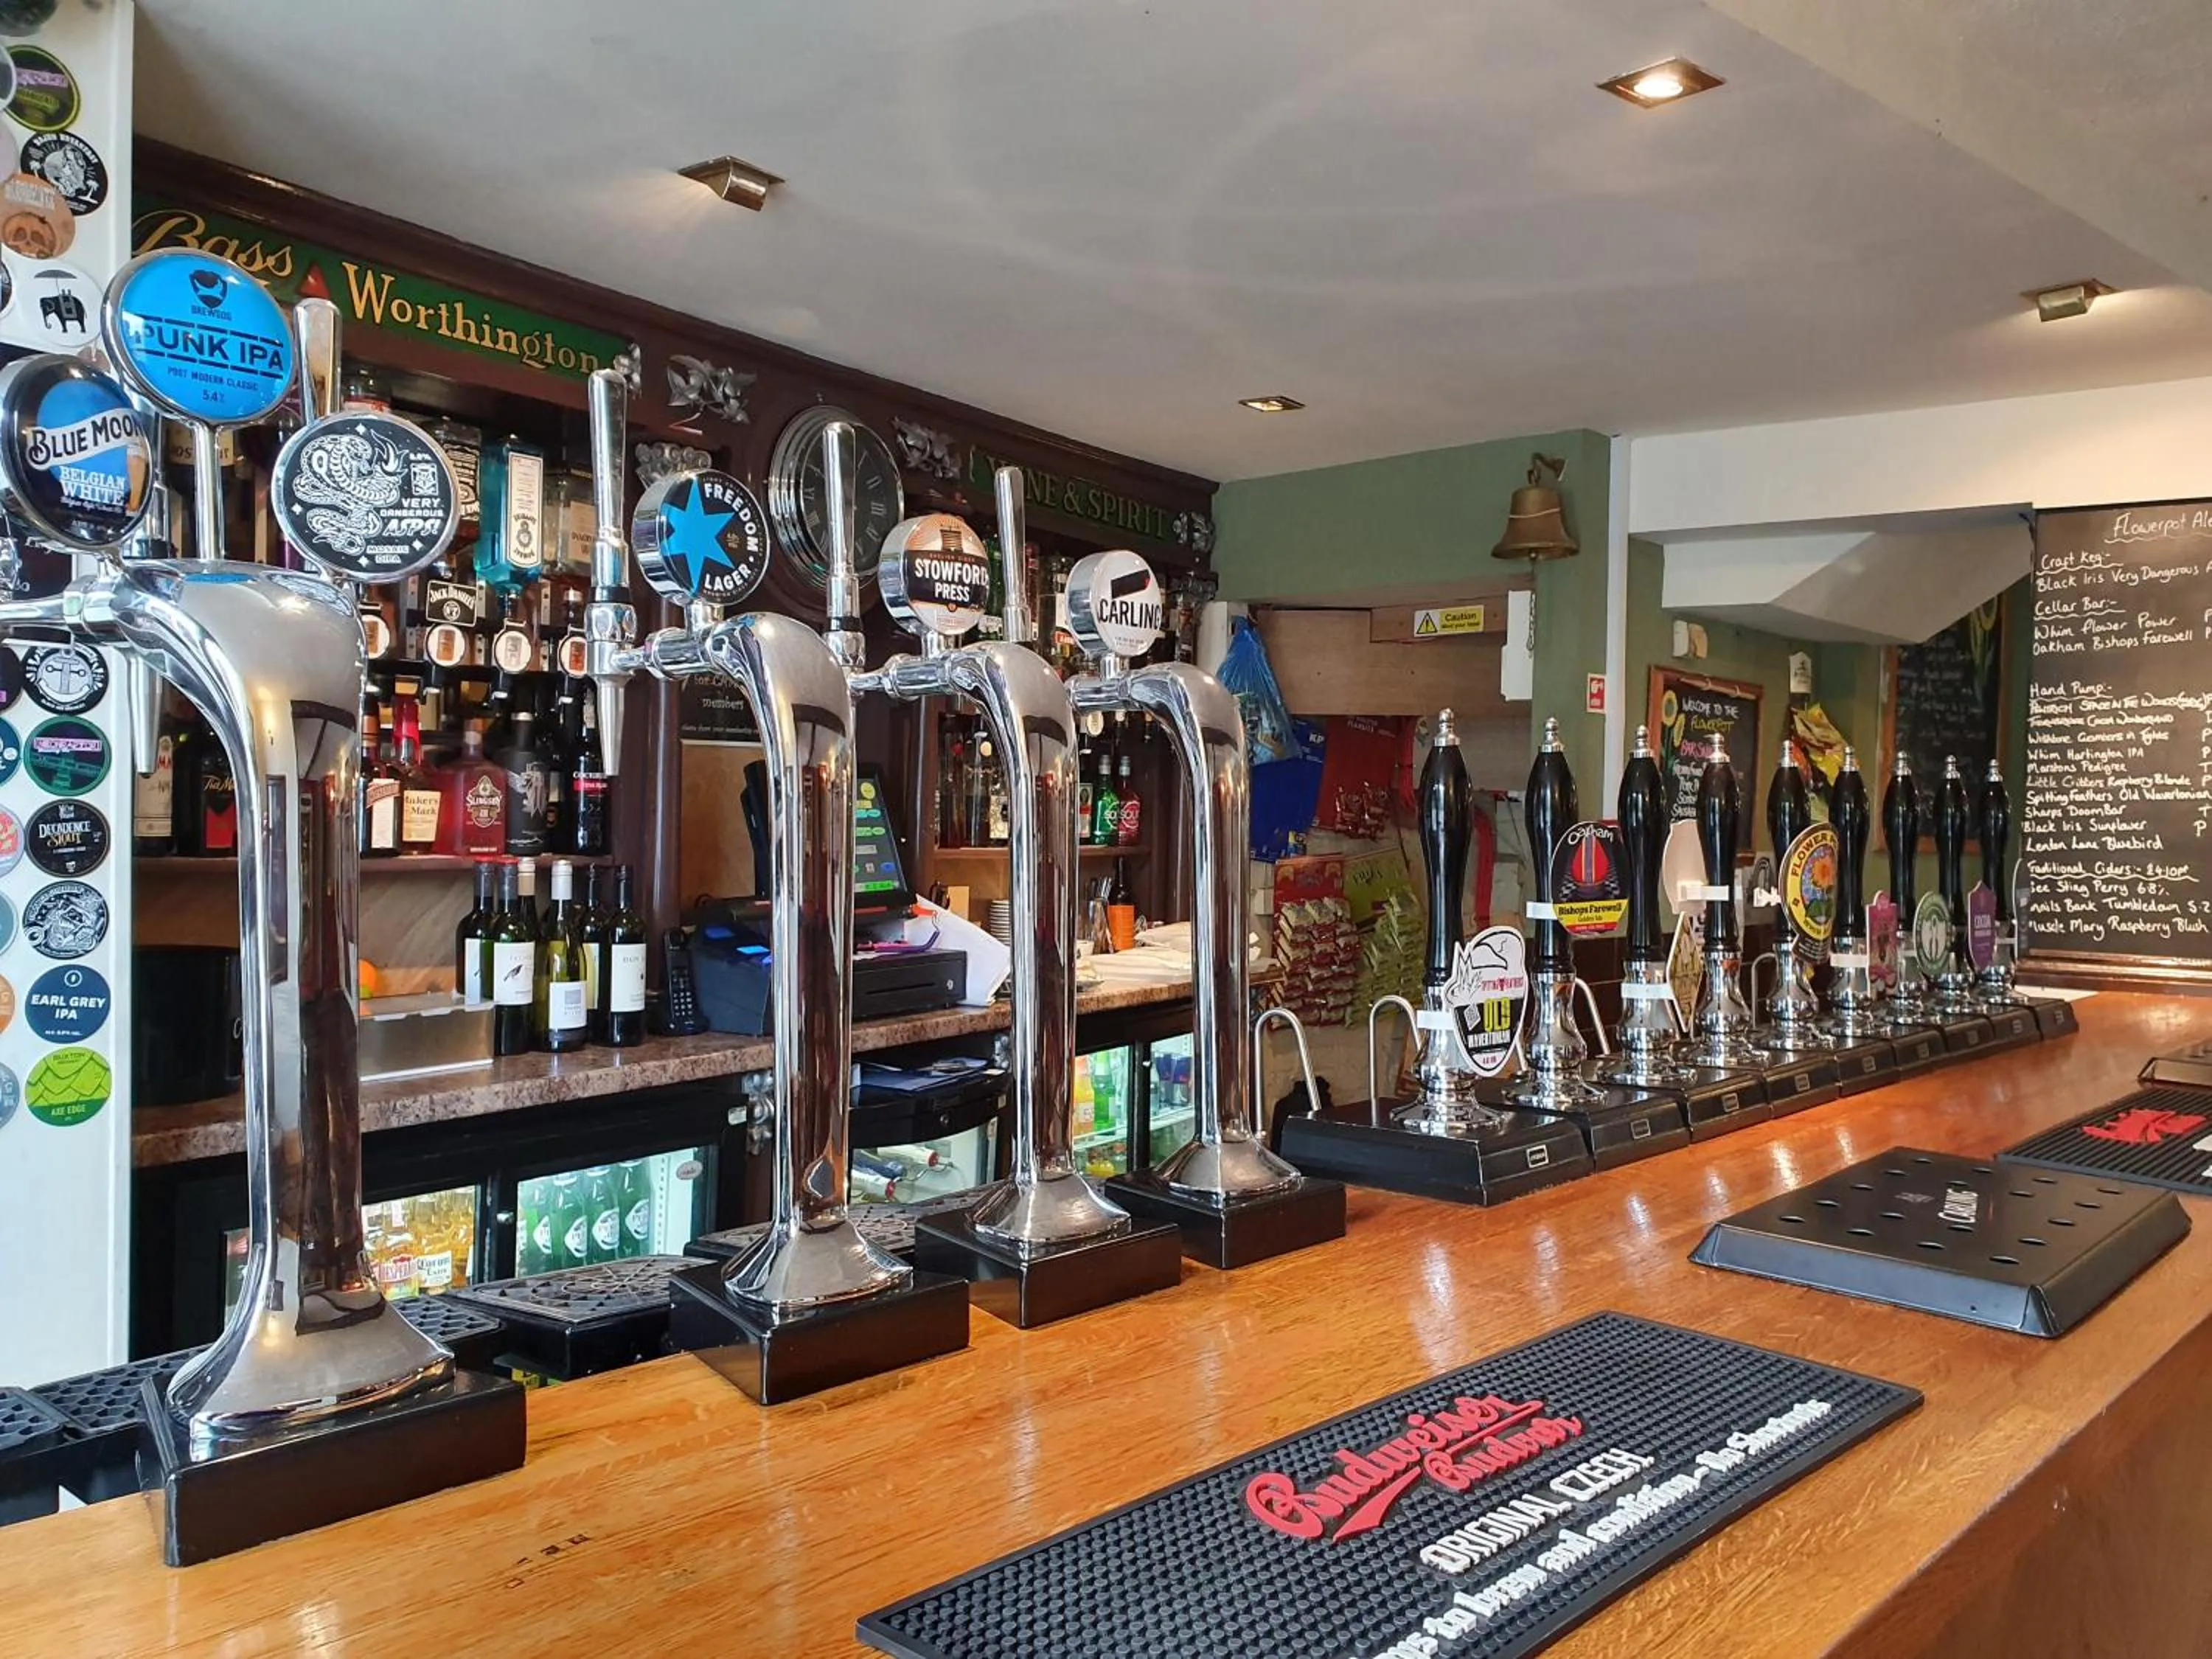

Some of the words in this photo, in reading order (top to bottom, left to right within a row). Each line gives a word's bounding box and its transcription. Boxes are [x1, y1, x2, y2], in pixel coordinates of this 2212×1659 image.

[341, 261, 599, 375] Worthington
[136, 321, 230, 362] PUNK
[239, 341, 284, 372] IPA
[28, 427, 88, 466] BLUE
[59, 465, 126, 490] BELGIAN
[60, 479, 125, 507] WHITE
[401, 498, 441, 508] VERY
[380, 509, 445, 518] DANGEROUS
[703, 482, 759, 552] FREEDOM
[704, 563, 752, 592] LAGER
[914, 557, 990, 587] STOWFORD
[2035, 575, 2077, 593] Black
[2083, 573, 2104, 585] Iris
[2111, 568, 2139, 586] Very
[2140, 564, 2199, 583] Dangerous
[934, 582, 970, 602] PRESS
[1099, 598, 1162, 630] CARLING
[1444, 613, 1477, 622] Caution
[2034, 601, 2077, 616] Cellar
[2034, 623, 2074, 640] Whim
[2138, 612, 2177, 629] Power
[2033, 641, 2085, 655] Oakham
[2142, 630, 2193, 645] Farewell
[2029, 681, 2066, 698] Hand
[2027, 748, 2061, 761] Whim
[2127, 747, 2145, 758] IPA
[2025, 805, 2063, 819] Sharps
[38, 821, 91, 838] DECADENCE
[1567, 824, 1613, 846] Oakham
[2023, 820, 2056, 833] Black
[2088, 818, 2147, 833] Sunflower
[1790, 832, 1828, 878] FLOWER
[2054, 881, 2090, 897] Sting
[2092, 879, 2129, 897] Perry
[1557, 905, 1589, 917] Bishops
[1589, 902, 1622, 914] Farewell
[2029, 899, 2061, 913] nails
[2064, 898, 2099, 913] Bank
[2069, 918, 2105, 942] Mary
[2107, 915, 2171, 939] Raspberry
[2171, 917, 2210, 933] Blush
[31, 993, 66, 1007] EARL
[69, 995, 107, 1009] GREY
[55, 1007, 78, 1020] IPA
[1483, 997, 1511, 1033] OLD
[1419, 1494, 1573, 1574] ORIGINAL
[1549, 1447, 1655, 1502] CZECH
